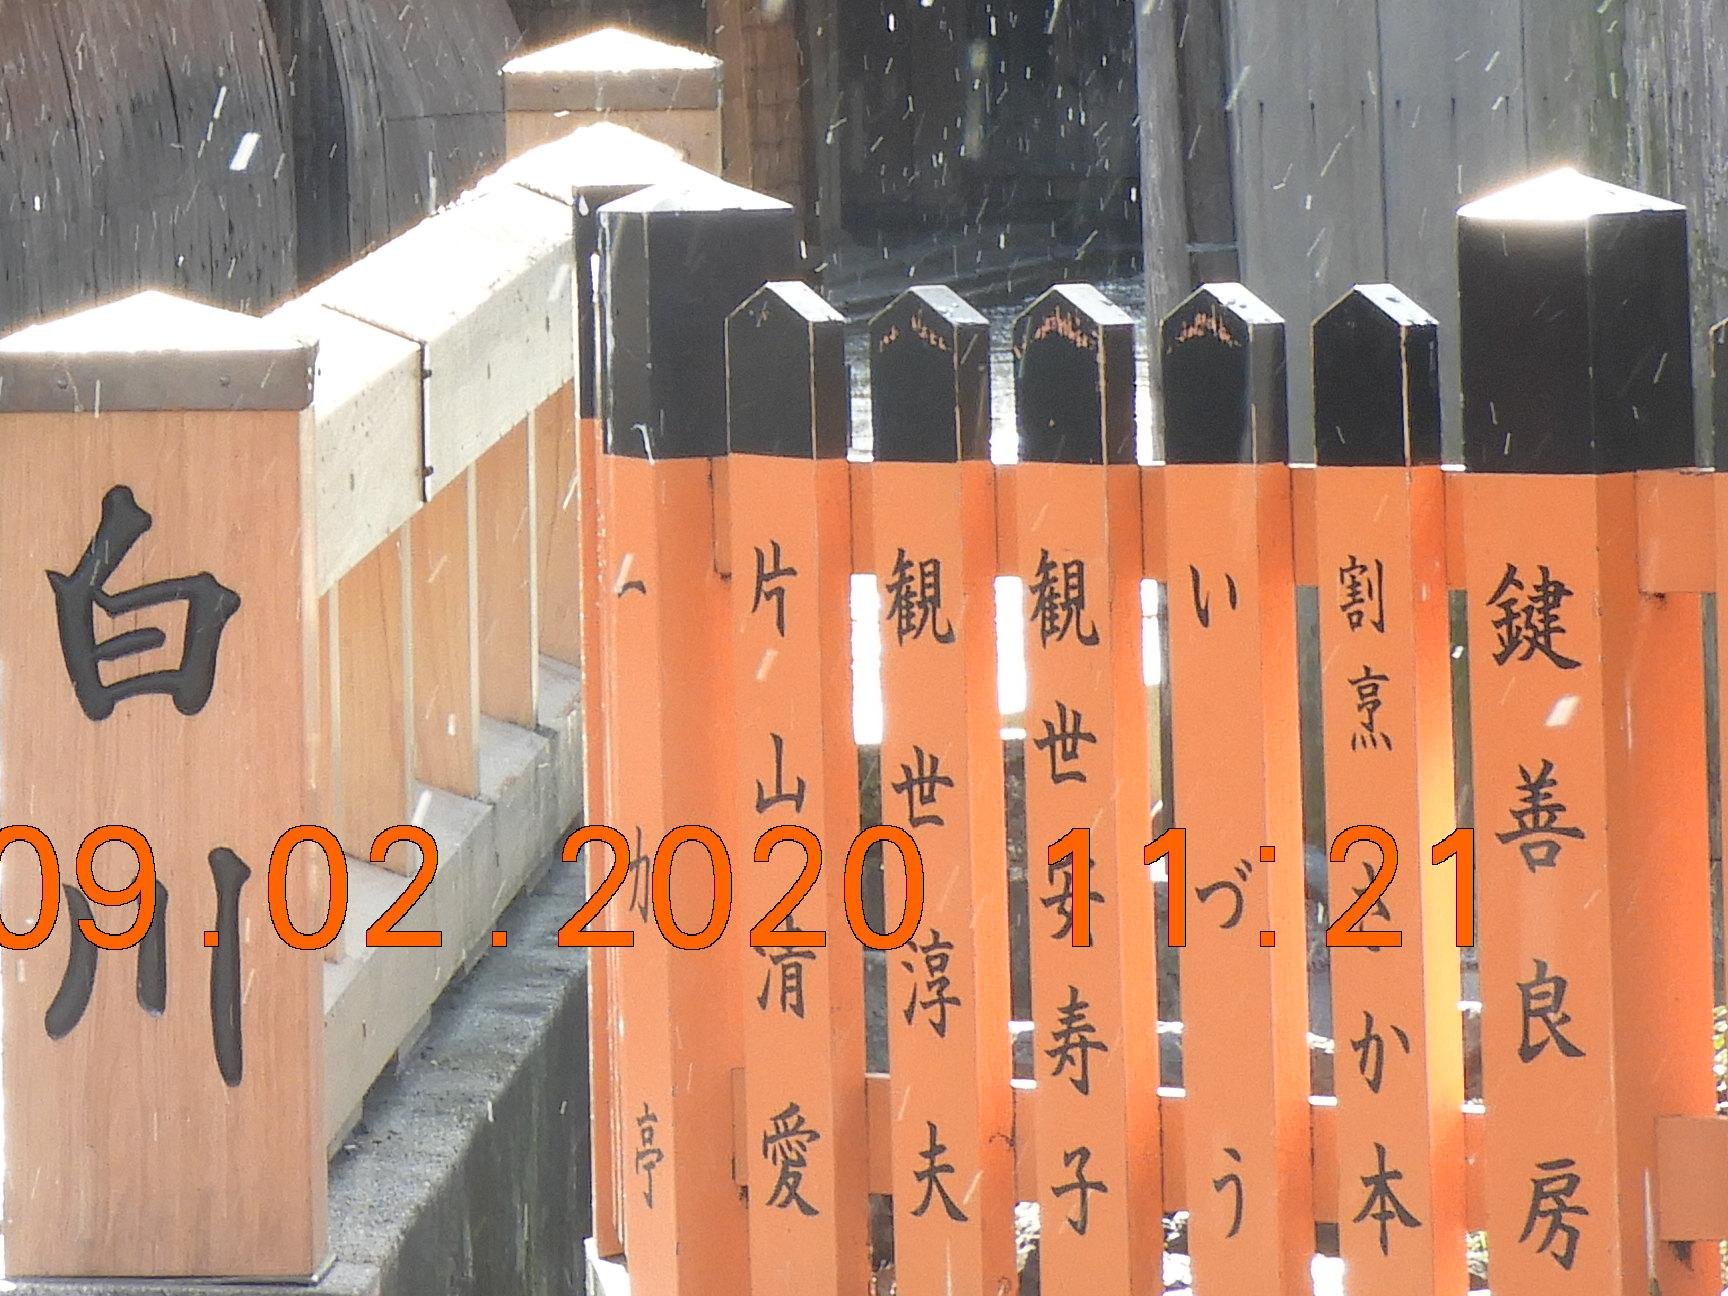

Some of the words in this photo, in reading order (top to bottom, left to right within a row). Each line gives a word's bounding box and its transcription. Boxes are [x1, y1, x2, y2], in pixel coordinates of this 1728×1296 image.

[45, 484, 251, 1088] 白川
[750, 540, 821, 1217] 片山清愛
[885, 547, 969, 1223] 観世淳夫
[1028, 547, 1110, 1237] 観世安寿子
[1189, 564, 1254, 1240] いづう
[1485, 563, 1590, 1272] 鍵善良房
